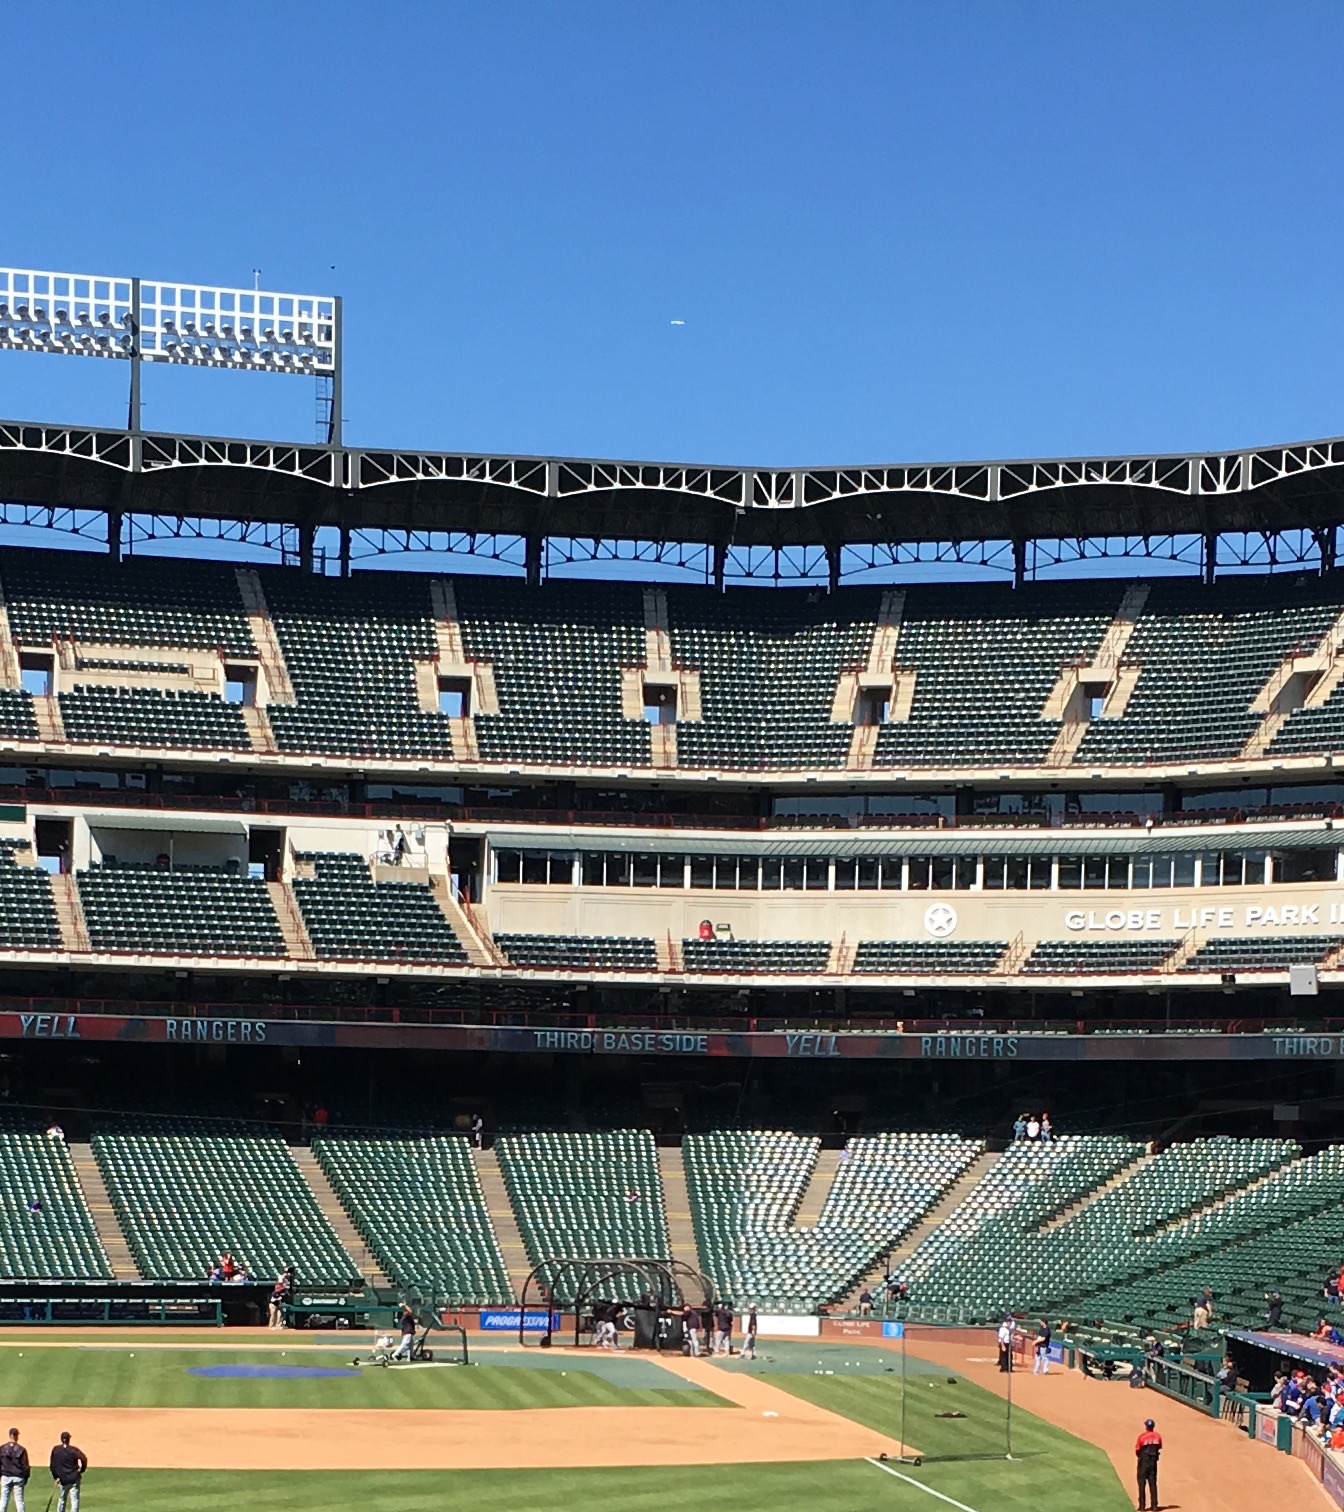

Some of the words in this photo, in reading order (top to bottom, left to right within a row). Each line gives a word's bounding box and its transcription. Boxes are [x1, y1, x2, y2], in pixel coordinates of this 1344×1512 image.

[1064, 909, 1161, 931] GLOBE
[1173, 907, 1234, 928] LIFE
[1246, 903, 1320, 927] PARK
[19, 1015, 81, 1038] YELL
[166, 1018, 267, 1042] RANGERS
[533, 1030, 593, 1050] THIRD
[603, 1032, 656, 1051] BASE
[662, 1033, 707, 1053] SIDE
[784, 1035, 841, 1056] YELL
[921, 1036, 1018, 1057] RANGERS
[1272, 1037, 1332, 1056] THIRD
